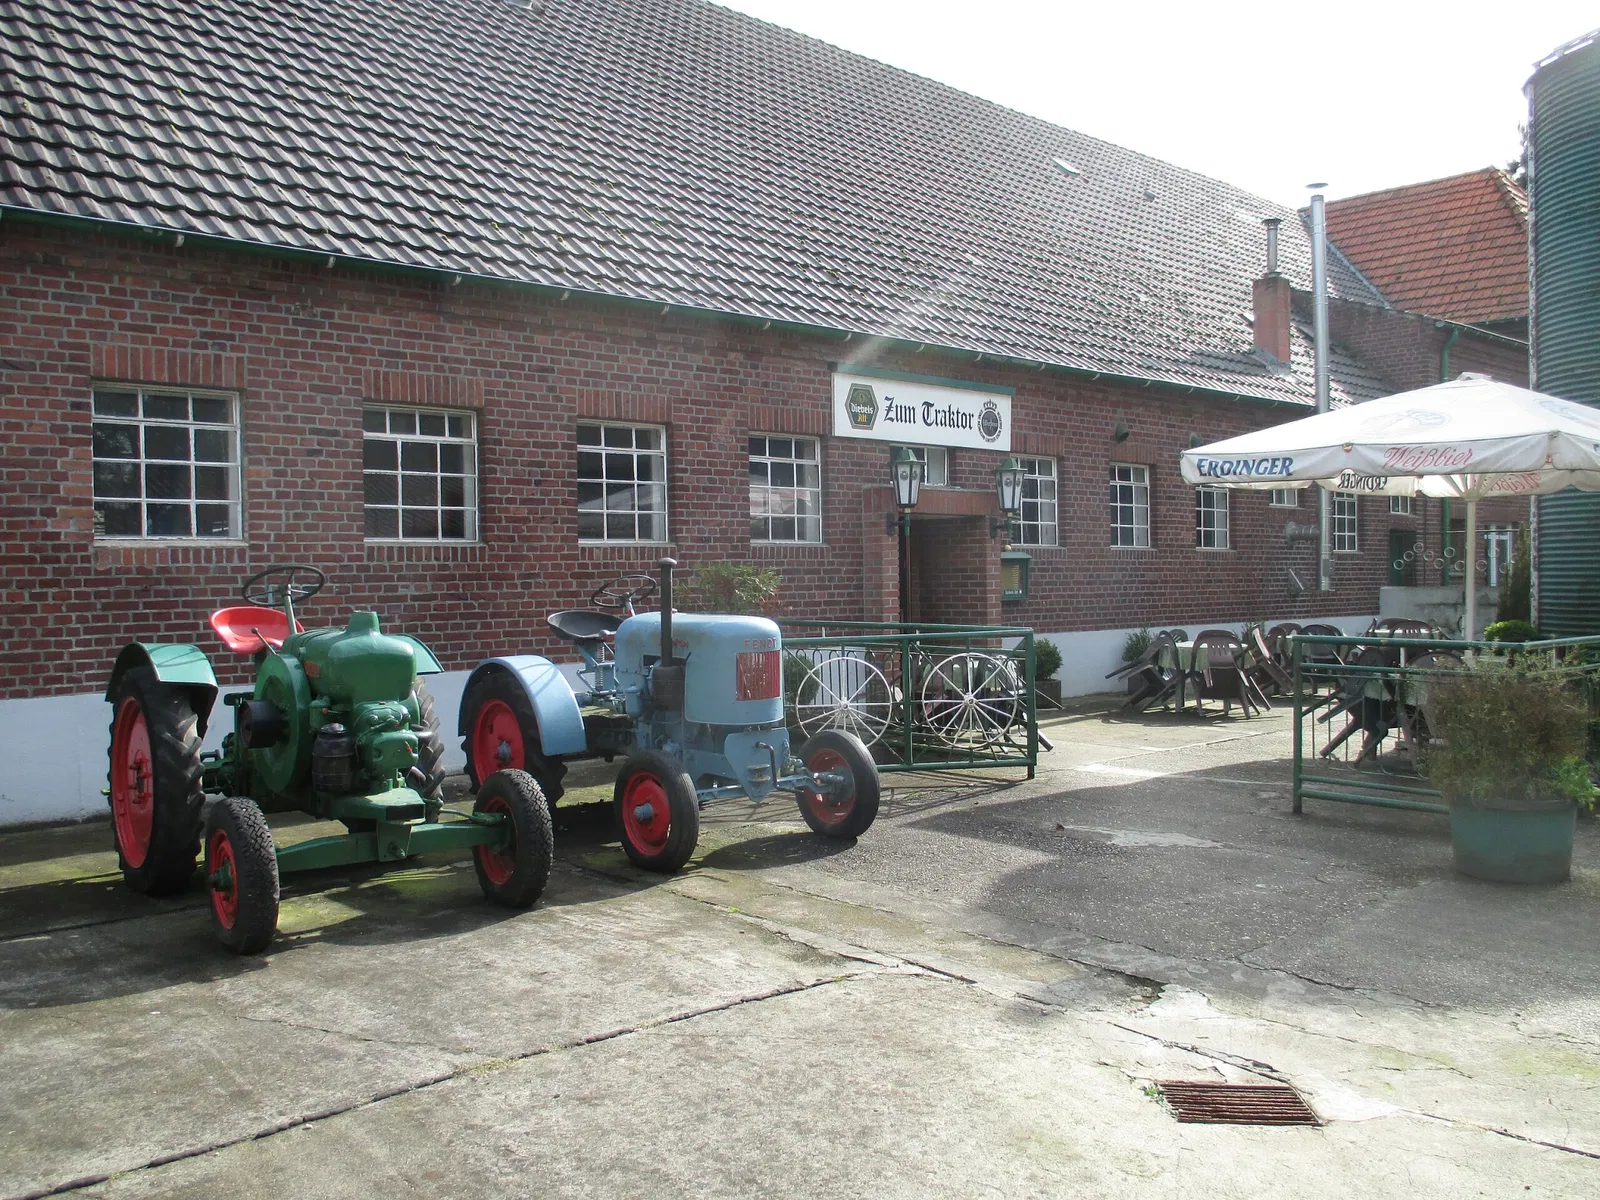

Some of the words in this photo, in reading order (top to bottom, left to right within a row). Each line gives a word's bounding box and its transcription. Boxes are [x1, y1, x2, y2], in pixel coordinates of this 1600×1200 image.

[850, 402, 874, 414] Diebels
[883, 396, 917, 424] Zum
[921, 401, 975, 430] Traktor
[1196, 457, 1294, 478] ERDINGER
[1383, 445, 1474, 472] Weißbier
[743, 637, 778, 650] FENDT
